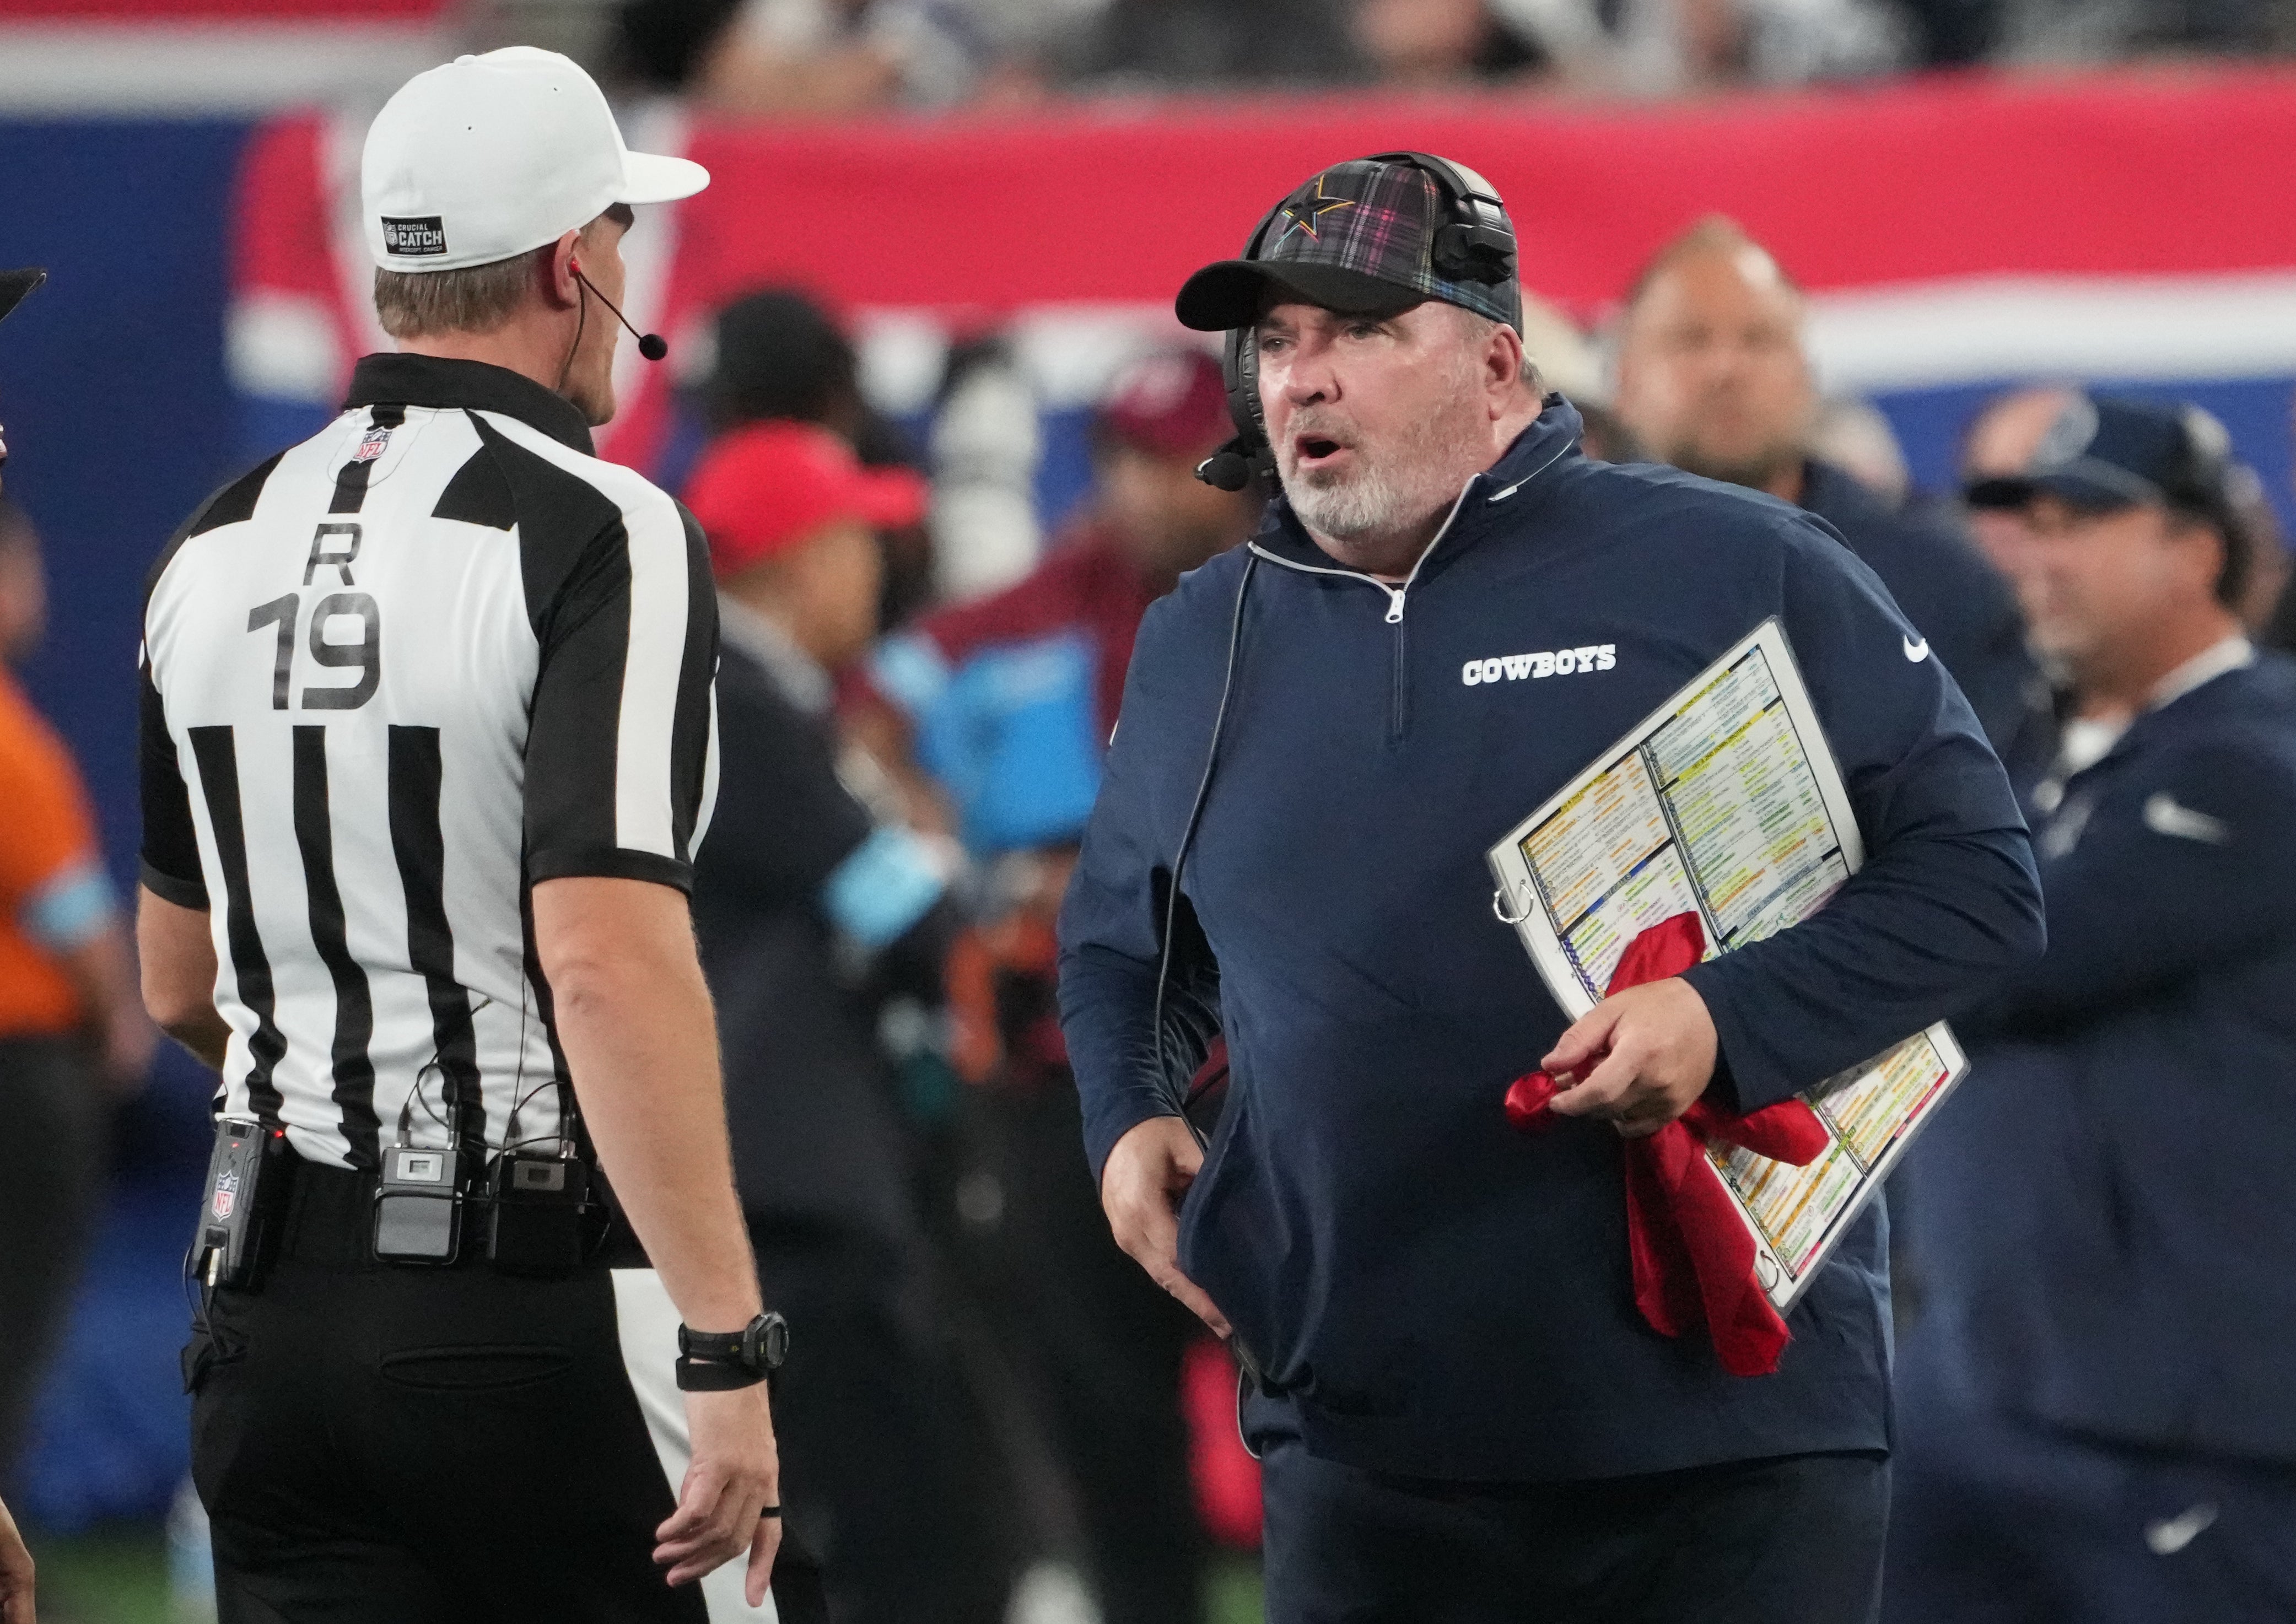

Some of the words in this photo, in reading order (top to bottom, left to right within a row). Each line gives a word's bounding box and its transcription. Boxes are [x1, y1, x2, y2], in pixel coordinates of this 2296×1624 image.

[398, 230, 443, 246] CATCH
[355, 443, 381, 458] NFL
[303, 523, 362, 586] R
[247, 592, 380, 710] 19
[1463, 644, 1616, 686] COWBOYS
[215, 1192, 230, 1213] NFL
